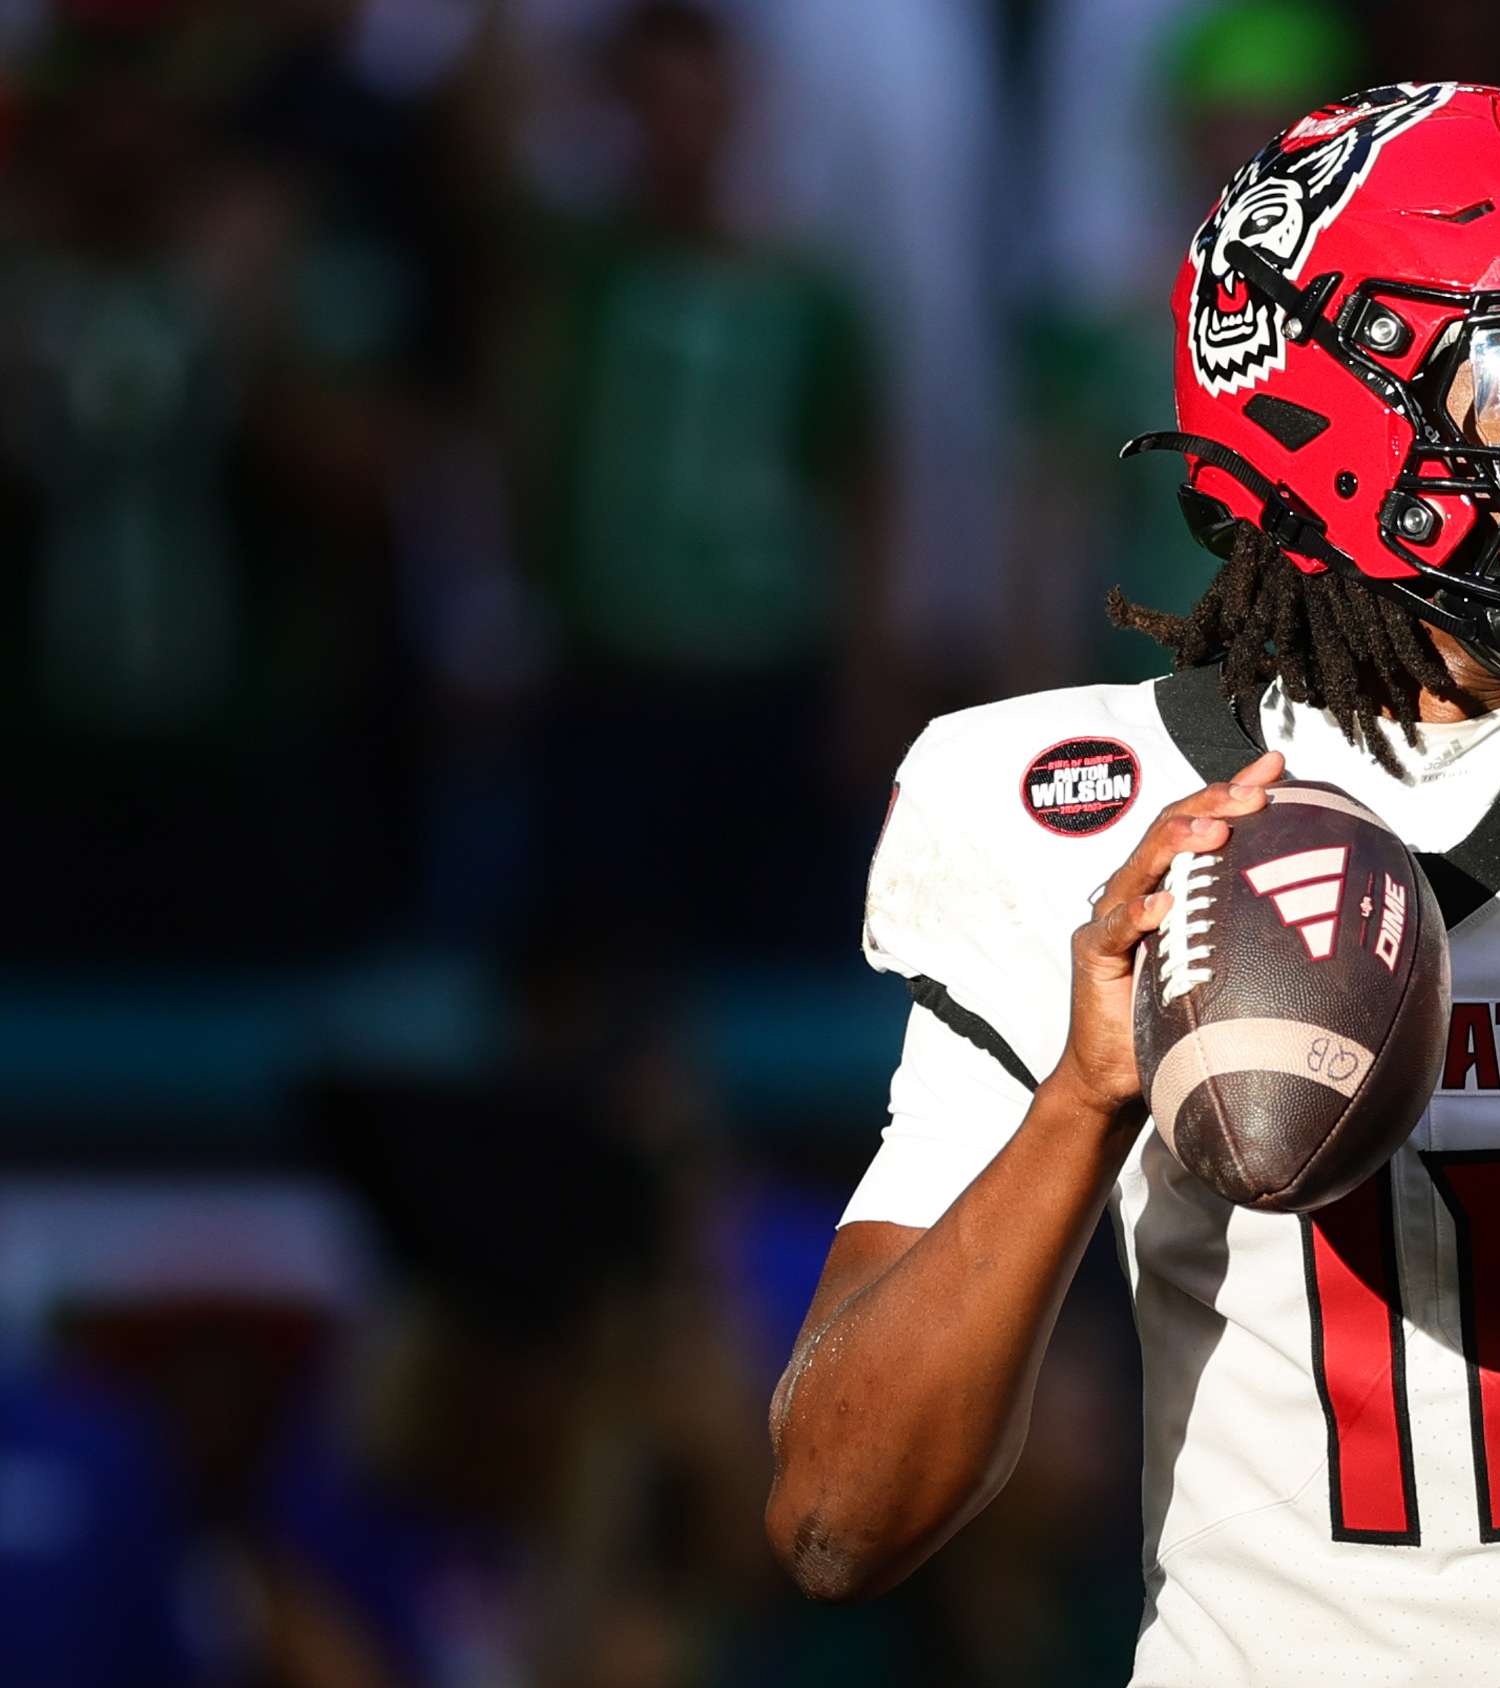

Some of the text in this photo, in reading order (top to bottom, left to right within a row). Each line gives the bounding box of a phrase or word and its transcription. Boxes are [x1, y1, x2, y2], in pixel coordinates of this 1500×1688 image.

[1053, 763, 1109, 784] PAYTON
[1031, 774, 1131, 808] WILSON
[1374, 872, 1407, 973] DIME
